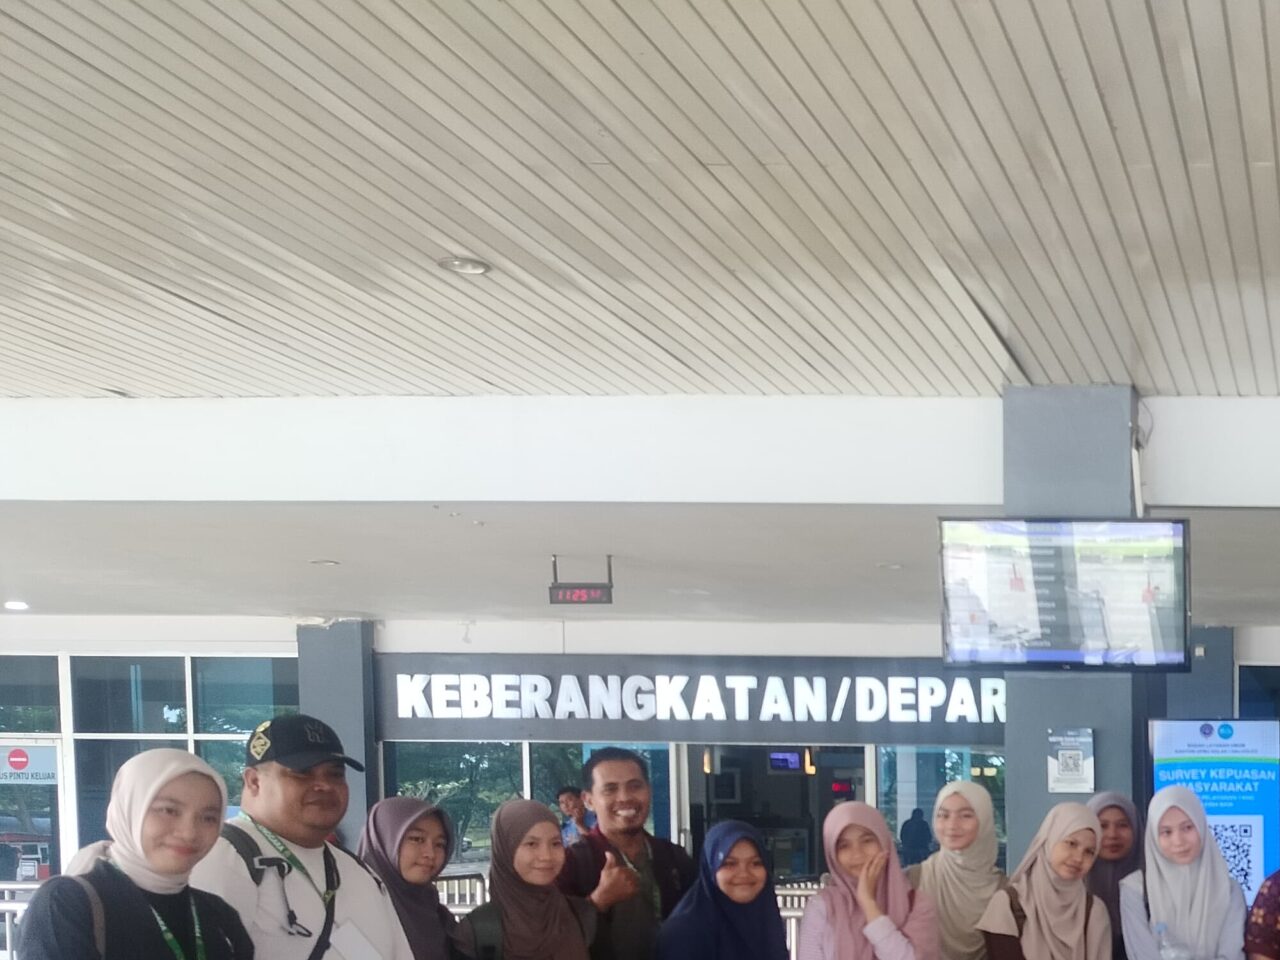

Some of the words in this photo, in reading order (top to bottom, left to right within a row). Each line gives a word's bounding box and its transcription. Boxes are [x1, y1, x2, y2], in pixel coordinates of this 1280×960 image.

[396, 674, 1006, 723] KEBERANGKATAN/DEPAR
[9, 772, 29, 780] PINTU
[31, 772, 56, 780] KELUAR
[1159, 769, 1207, 782] SURVEY
[1210, 768, 1276, 781] KEPUASAN
